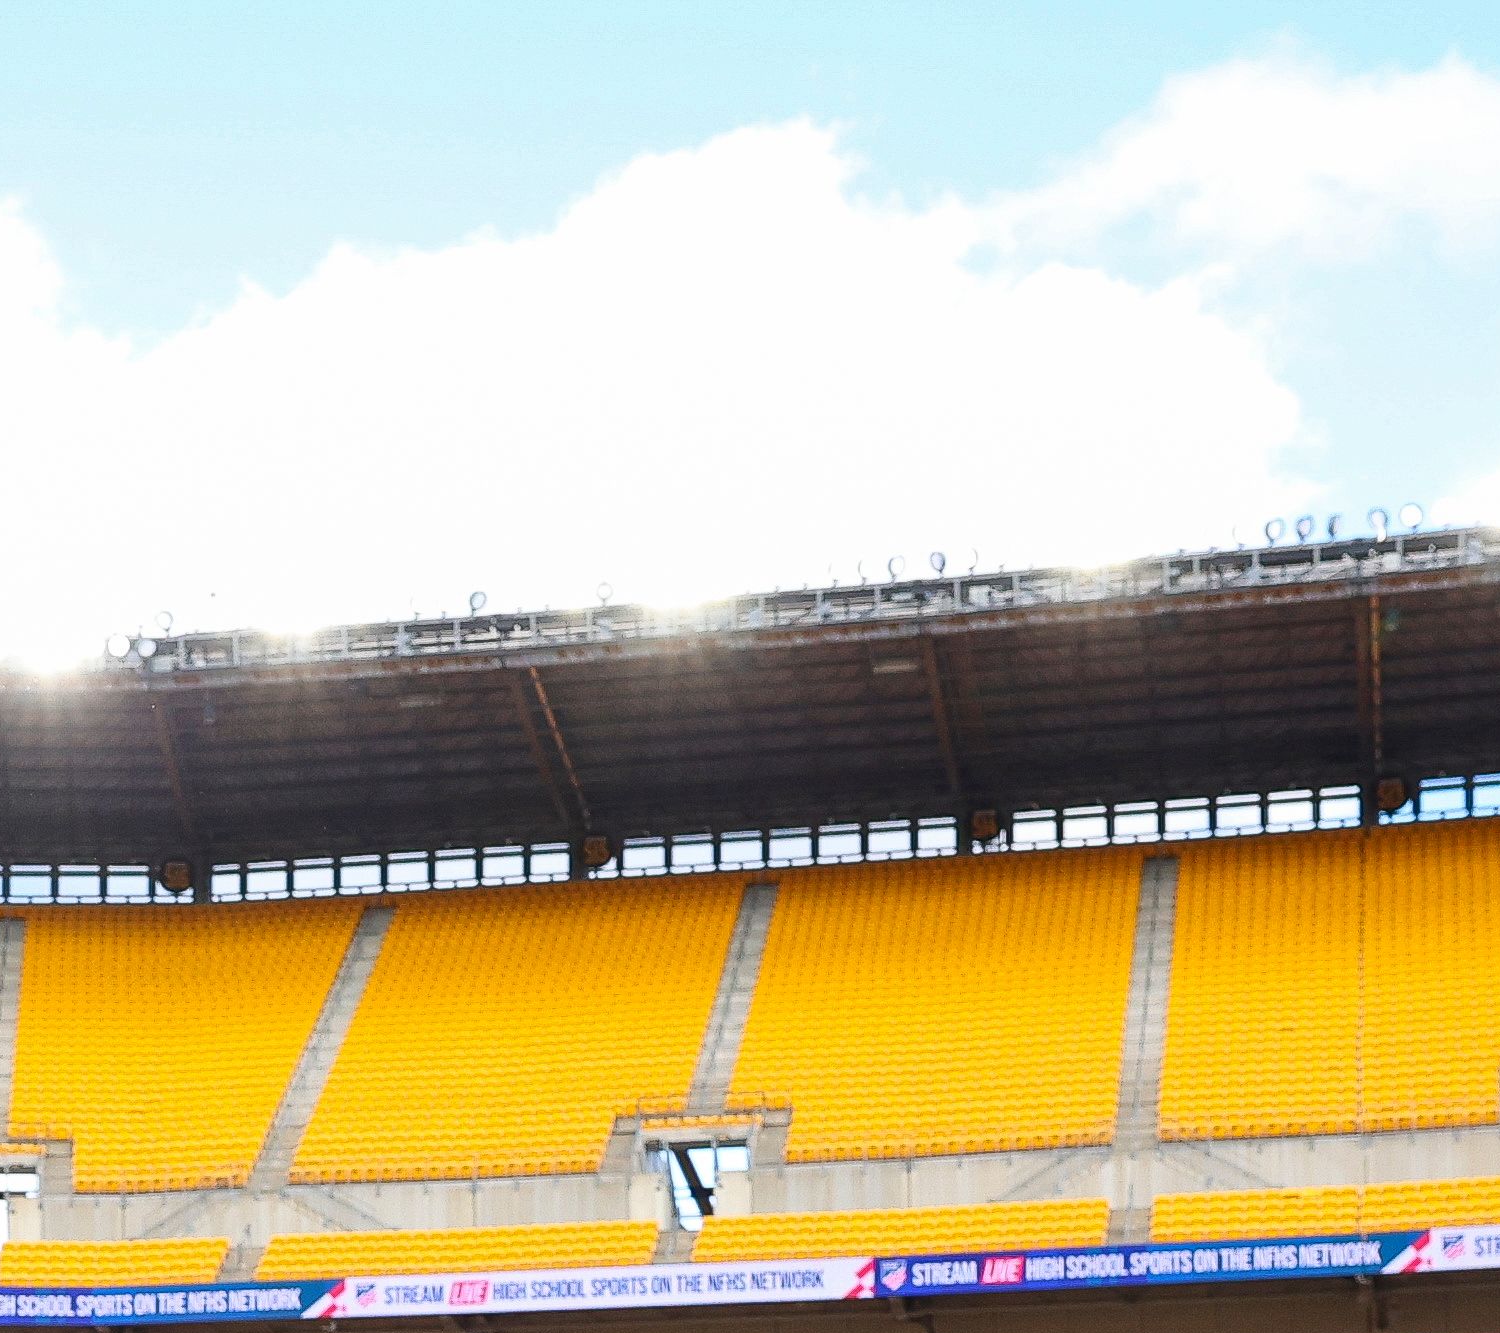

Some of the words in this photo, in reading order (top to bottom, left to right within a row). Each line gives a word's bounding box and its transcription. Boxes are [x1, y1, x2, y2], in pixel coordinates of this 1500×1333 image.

[912, 1260, 978, 1287] STREAM
[982, 1258, 1023, 1284] LIVE
[1025, 1256, 1064, 1281] HIGH
[1066, 1253, 1128, 1280] SCHOOL
[1129, 1250, 1192, 1275] SPORTS
[1193, 1249, 1218, 1273] ON
[1220, 1247, 1251, 1271] THE
[1299, 1241, 1382, 1268] NETWORK
[17, 1294, 75, 1317] SCHOOL
[76, 1294, 132, 1317] SPORTS
[134, 1293, 156, 1315] ON
[158, 1292, 186, 1314] THE
[229, 1288, 302, 1312] NETWORK
[384, 1284, 444, 1305] STREAM
[493, 1282, 526, 1300] HIGH
[530, 1280, 586, 1299] SCHOOL
[590, 1276, 647, 1297] SPORTS
[651, 1275, 671, 1294] ON
[676, 1274, 701, 1293] THE
[750, 1270, 824, 1289] NETWORK
